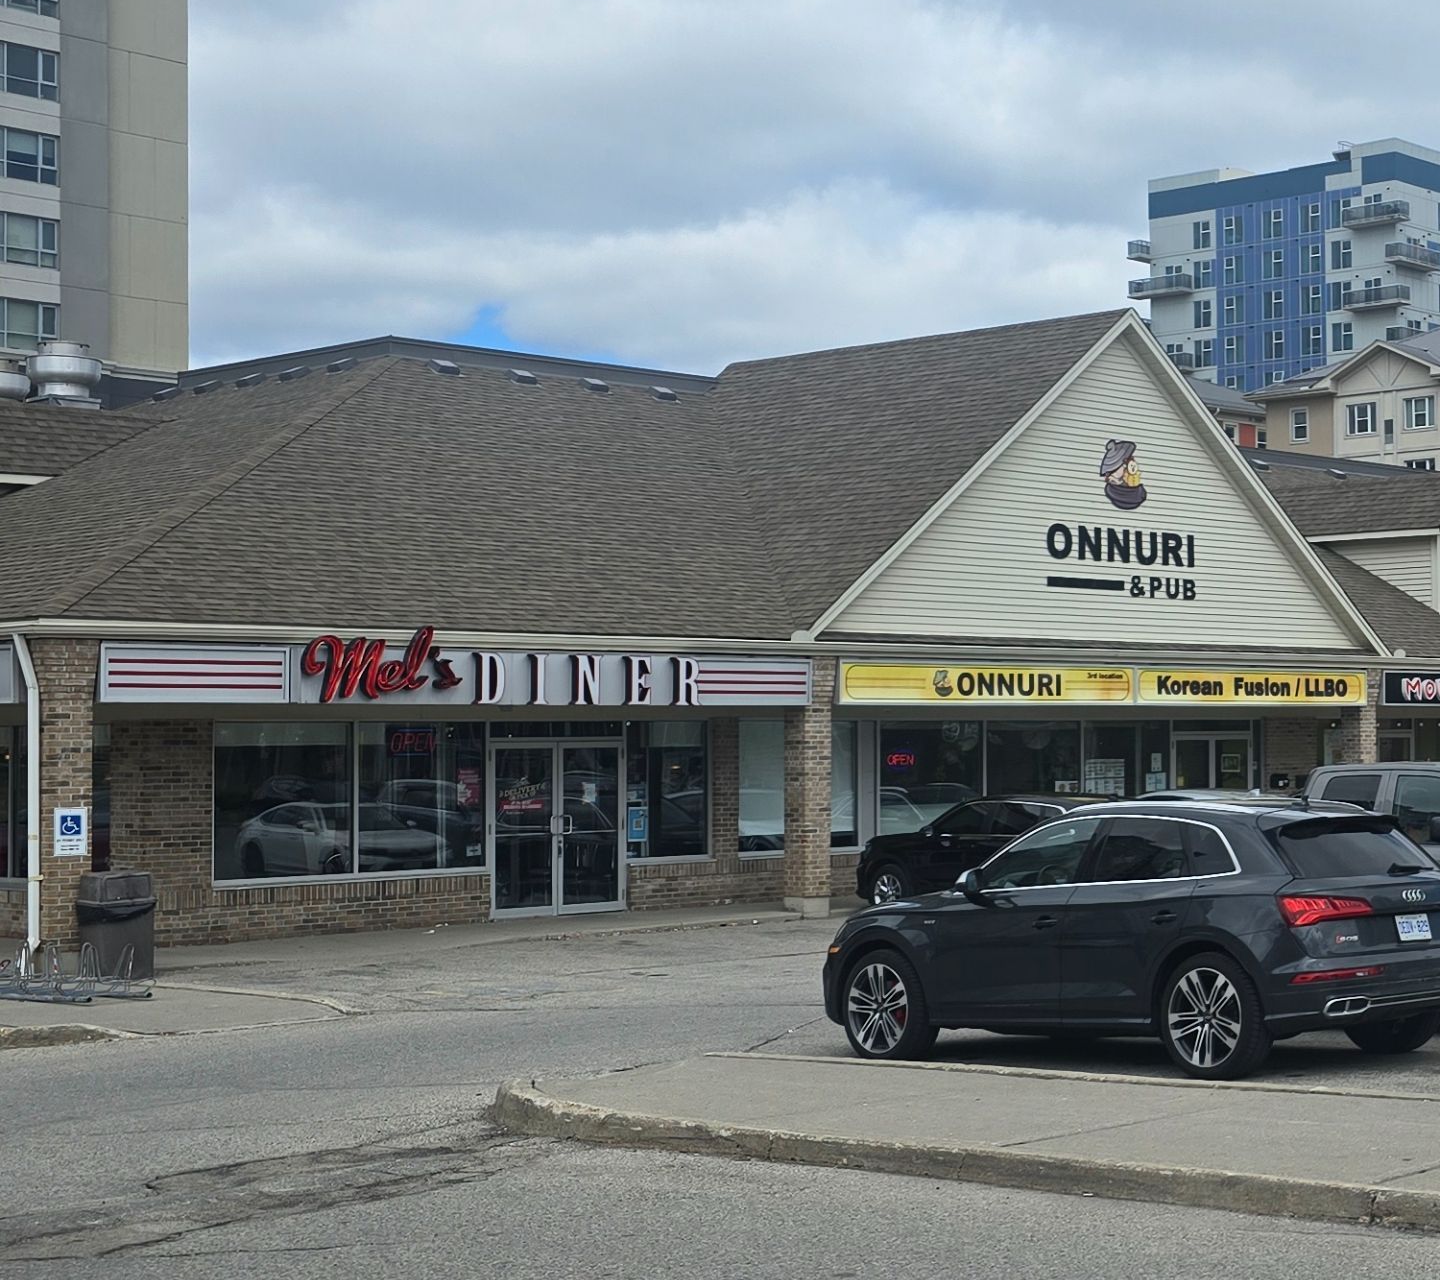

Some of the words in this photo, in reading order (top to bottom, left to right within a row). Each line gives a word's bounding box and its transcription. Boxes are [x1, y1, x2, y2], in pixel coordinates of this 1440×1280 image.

[1046, 523, 1195, 568] ONNURI
[302, 625, 463, 704] Mel's
[471, 651, 700, 706] DINER
[956, 672, 1062, 697] ONNURI
[1157, 675, 1223, 696] Korean
[1234, 677, 1290, 697] Fusion
[1305, 678, 1348, 697] LLBO
[887, 754, 914, 766] OPEN
